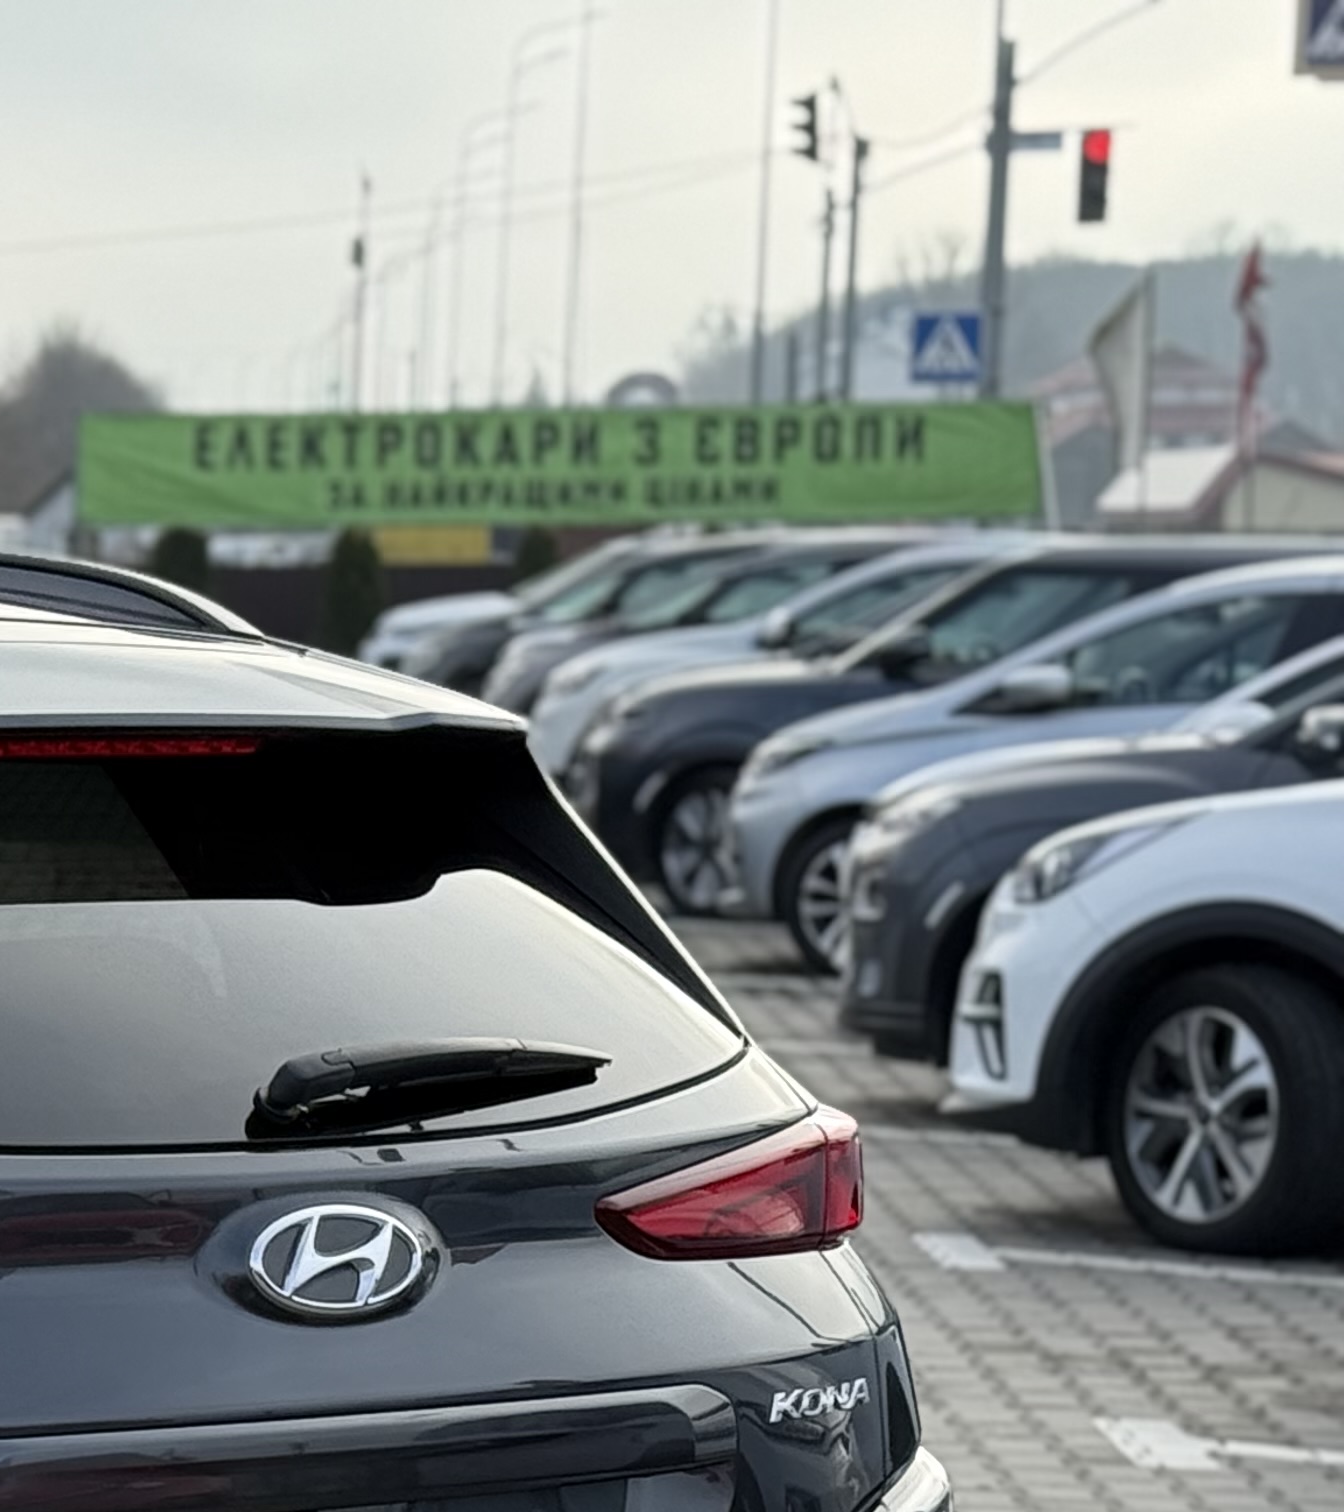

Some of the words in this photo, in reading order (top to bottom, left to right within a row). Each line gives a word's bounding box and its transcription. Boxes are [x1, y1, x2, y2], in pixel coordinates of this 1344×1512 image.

[193, 414, 600, 473] ЕЛЕКТРОКАРИ
[695, 411, 927, 467] ЄВРОПИ
[769, 1377, 871, 1424] KONA
